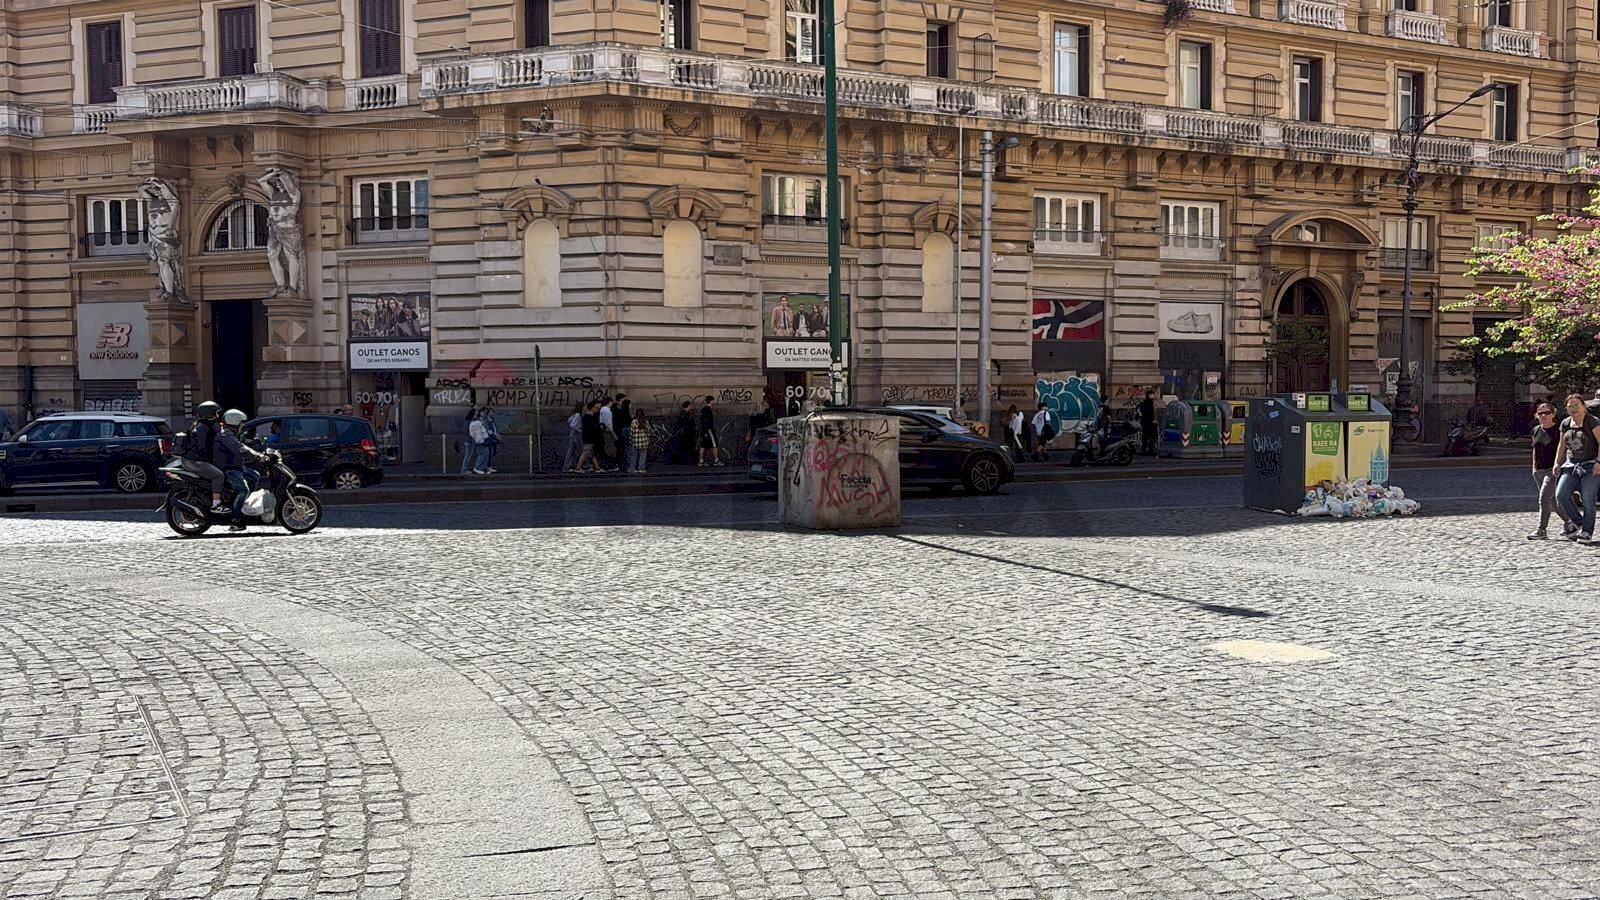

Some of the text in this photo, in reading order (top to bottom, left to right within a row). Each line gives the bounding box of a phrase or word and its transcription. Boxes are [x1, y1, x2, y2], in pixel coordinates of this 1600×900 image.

[106, 350, 138, 360] balance
[357, 348, 421, 357] OUTLET GANOS
[774, 347, 808, 356] OUTLET
[785, 385, 826, 398] 60 70
